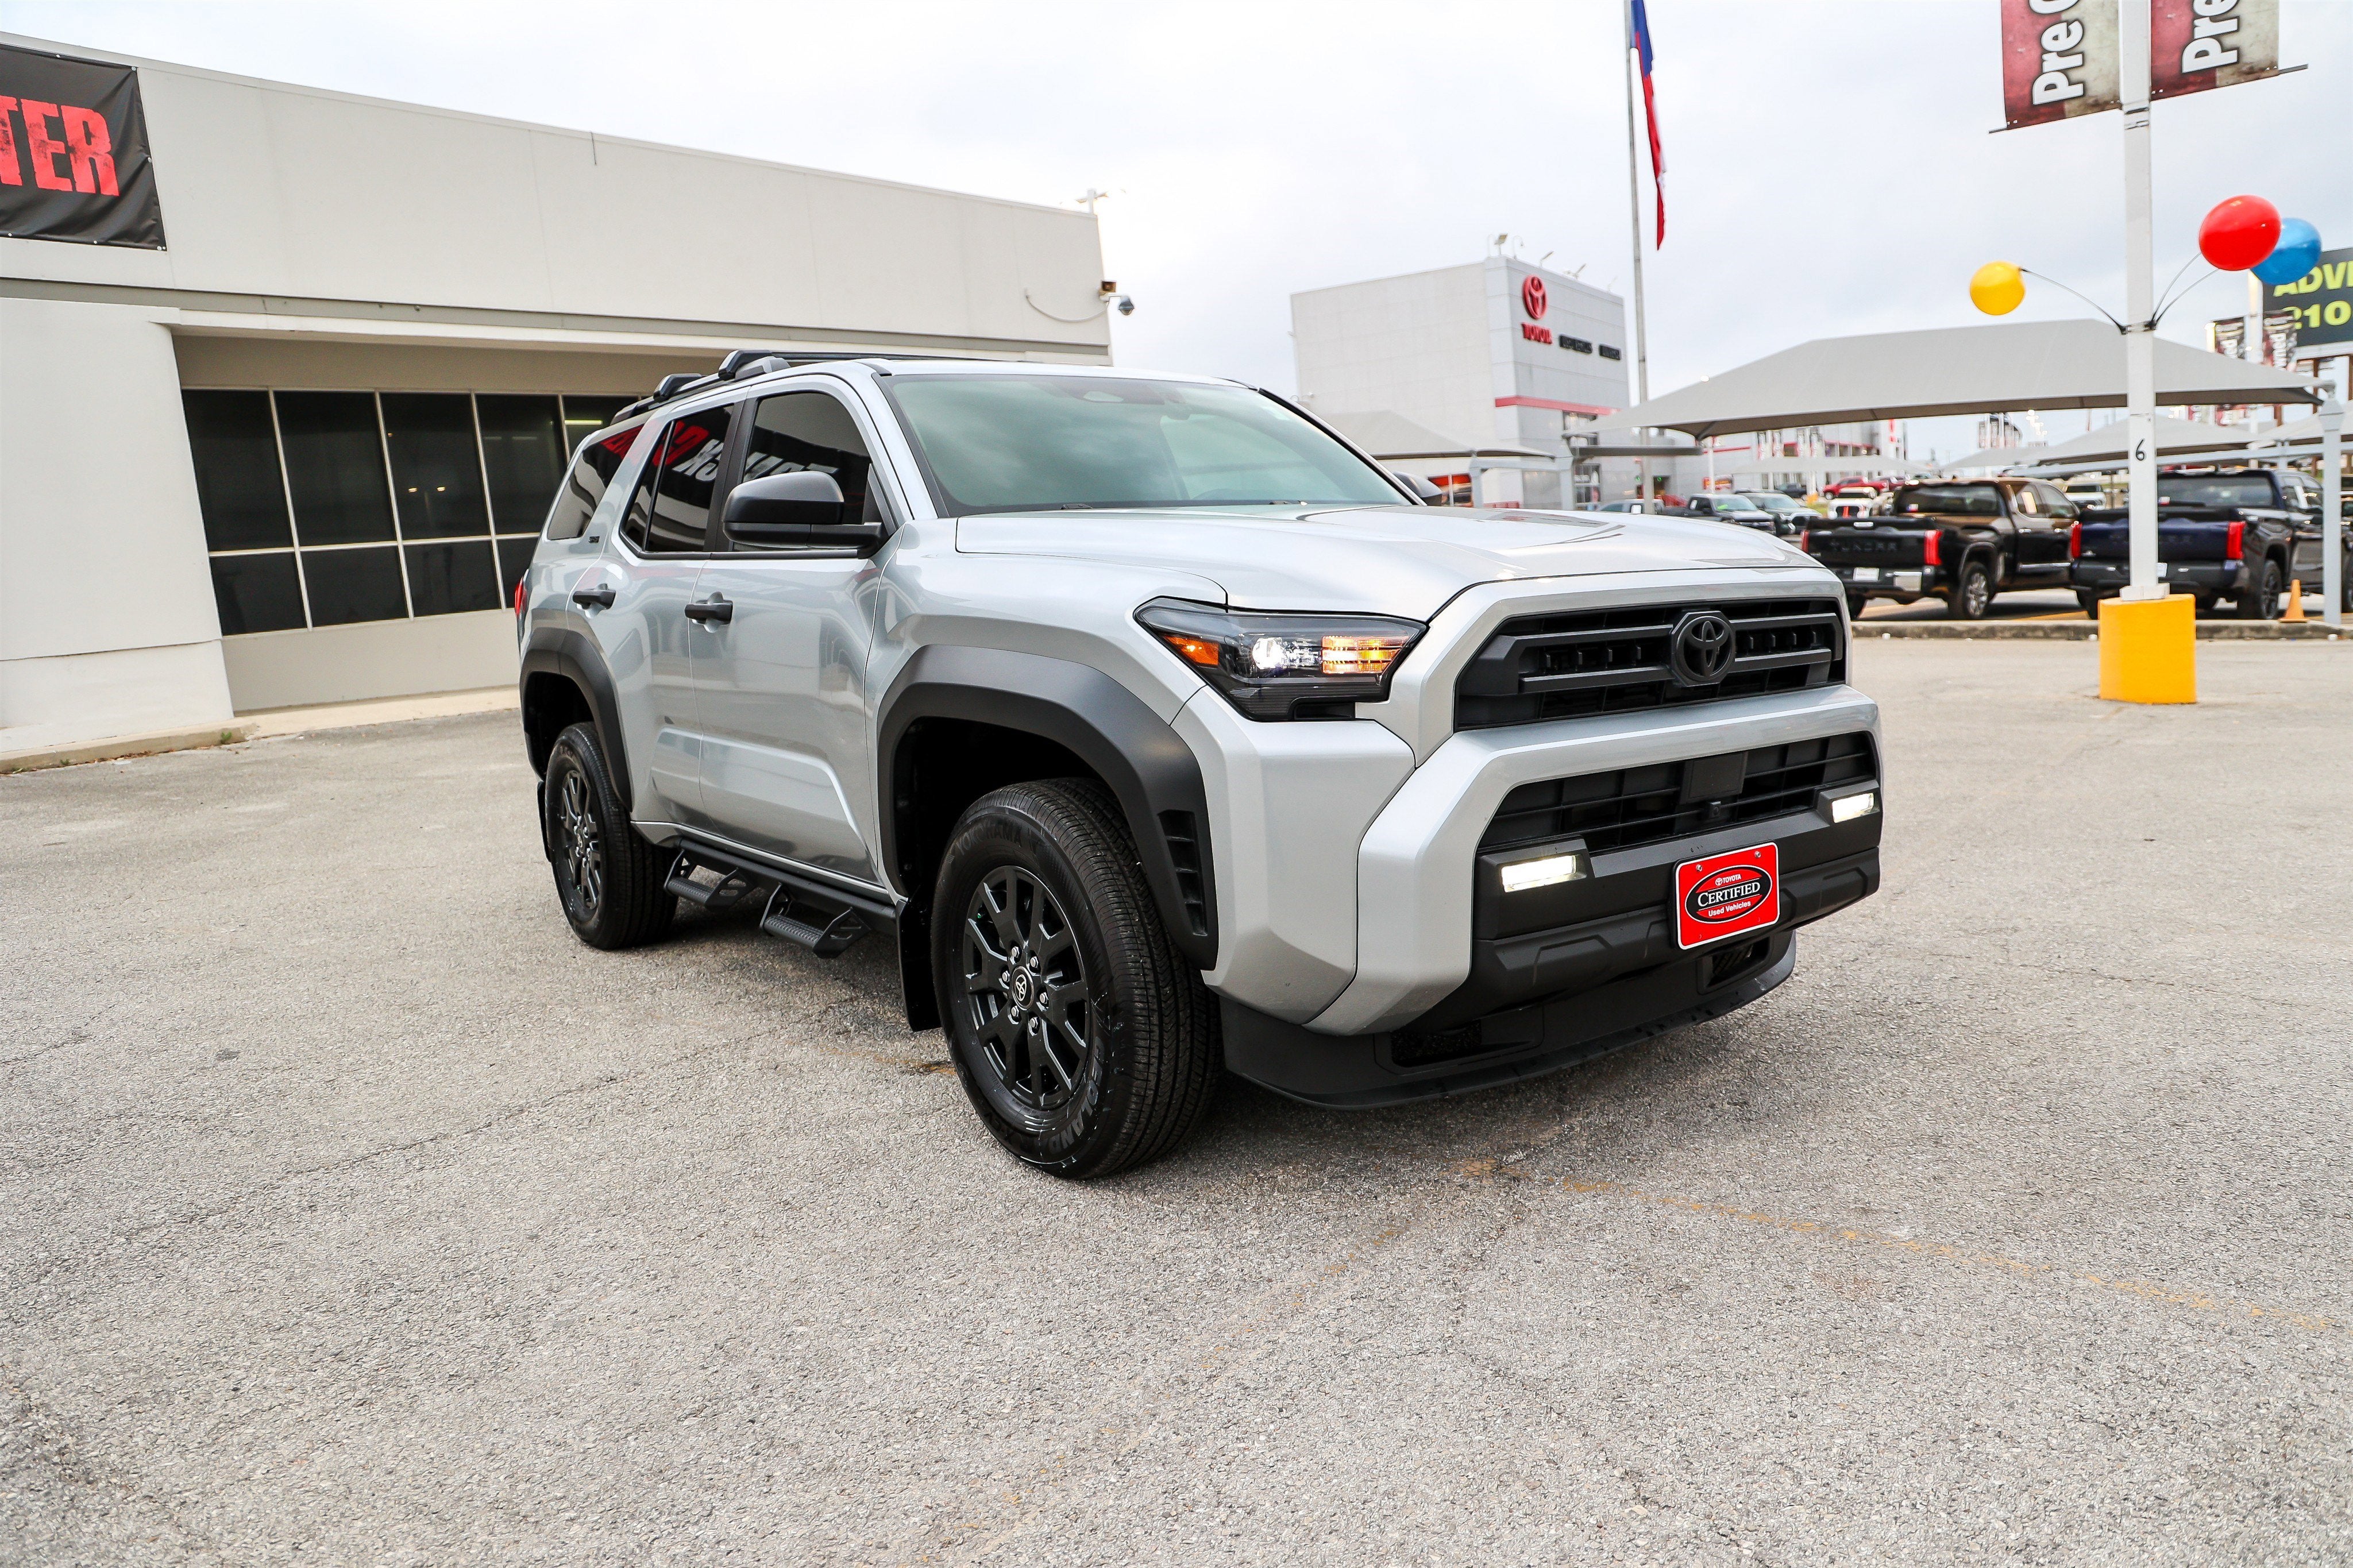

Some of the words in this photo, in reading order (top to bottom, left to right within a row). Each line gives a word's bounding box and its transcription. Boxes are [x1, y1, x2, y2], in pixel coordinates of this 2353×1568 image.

[2031, 20, 2084, 105] Pre
[2135, 439, 2145, 461] 6
[1723, 874, 1742, 884] TOYOTA
[1698, 882, 1761, 907] CERTIFIED
[1708, 907, 1725, 917] Used
[1725, 901, 1752, 913] Vehicles
